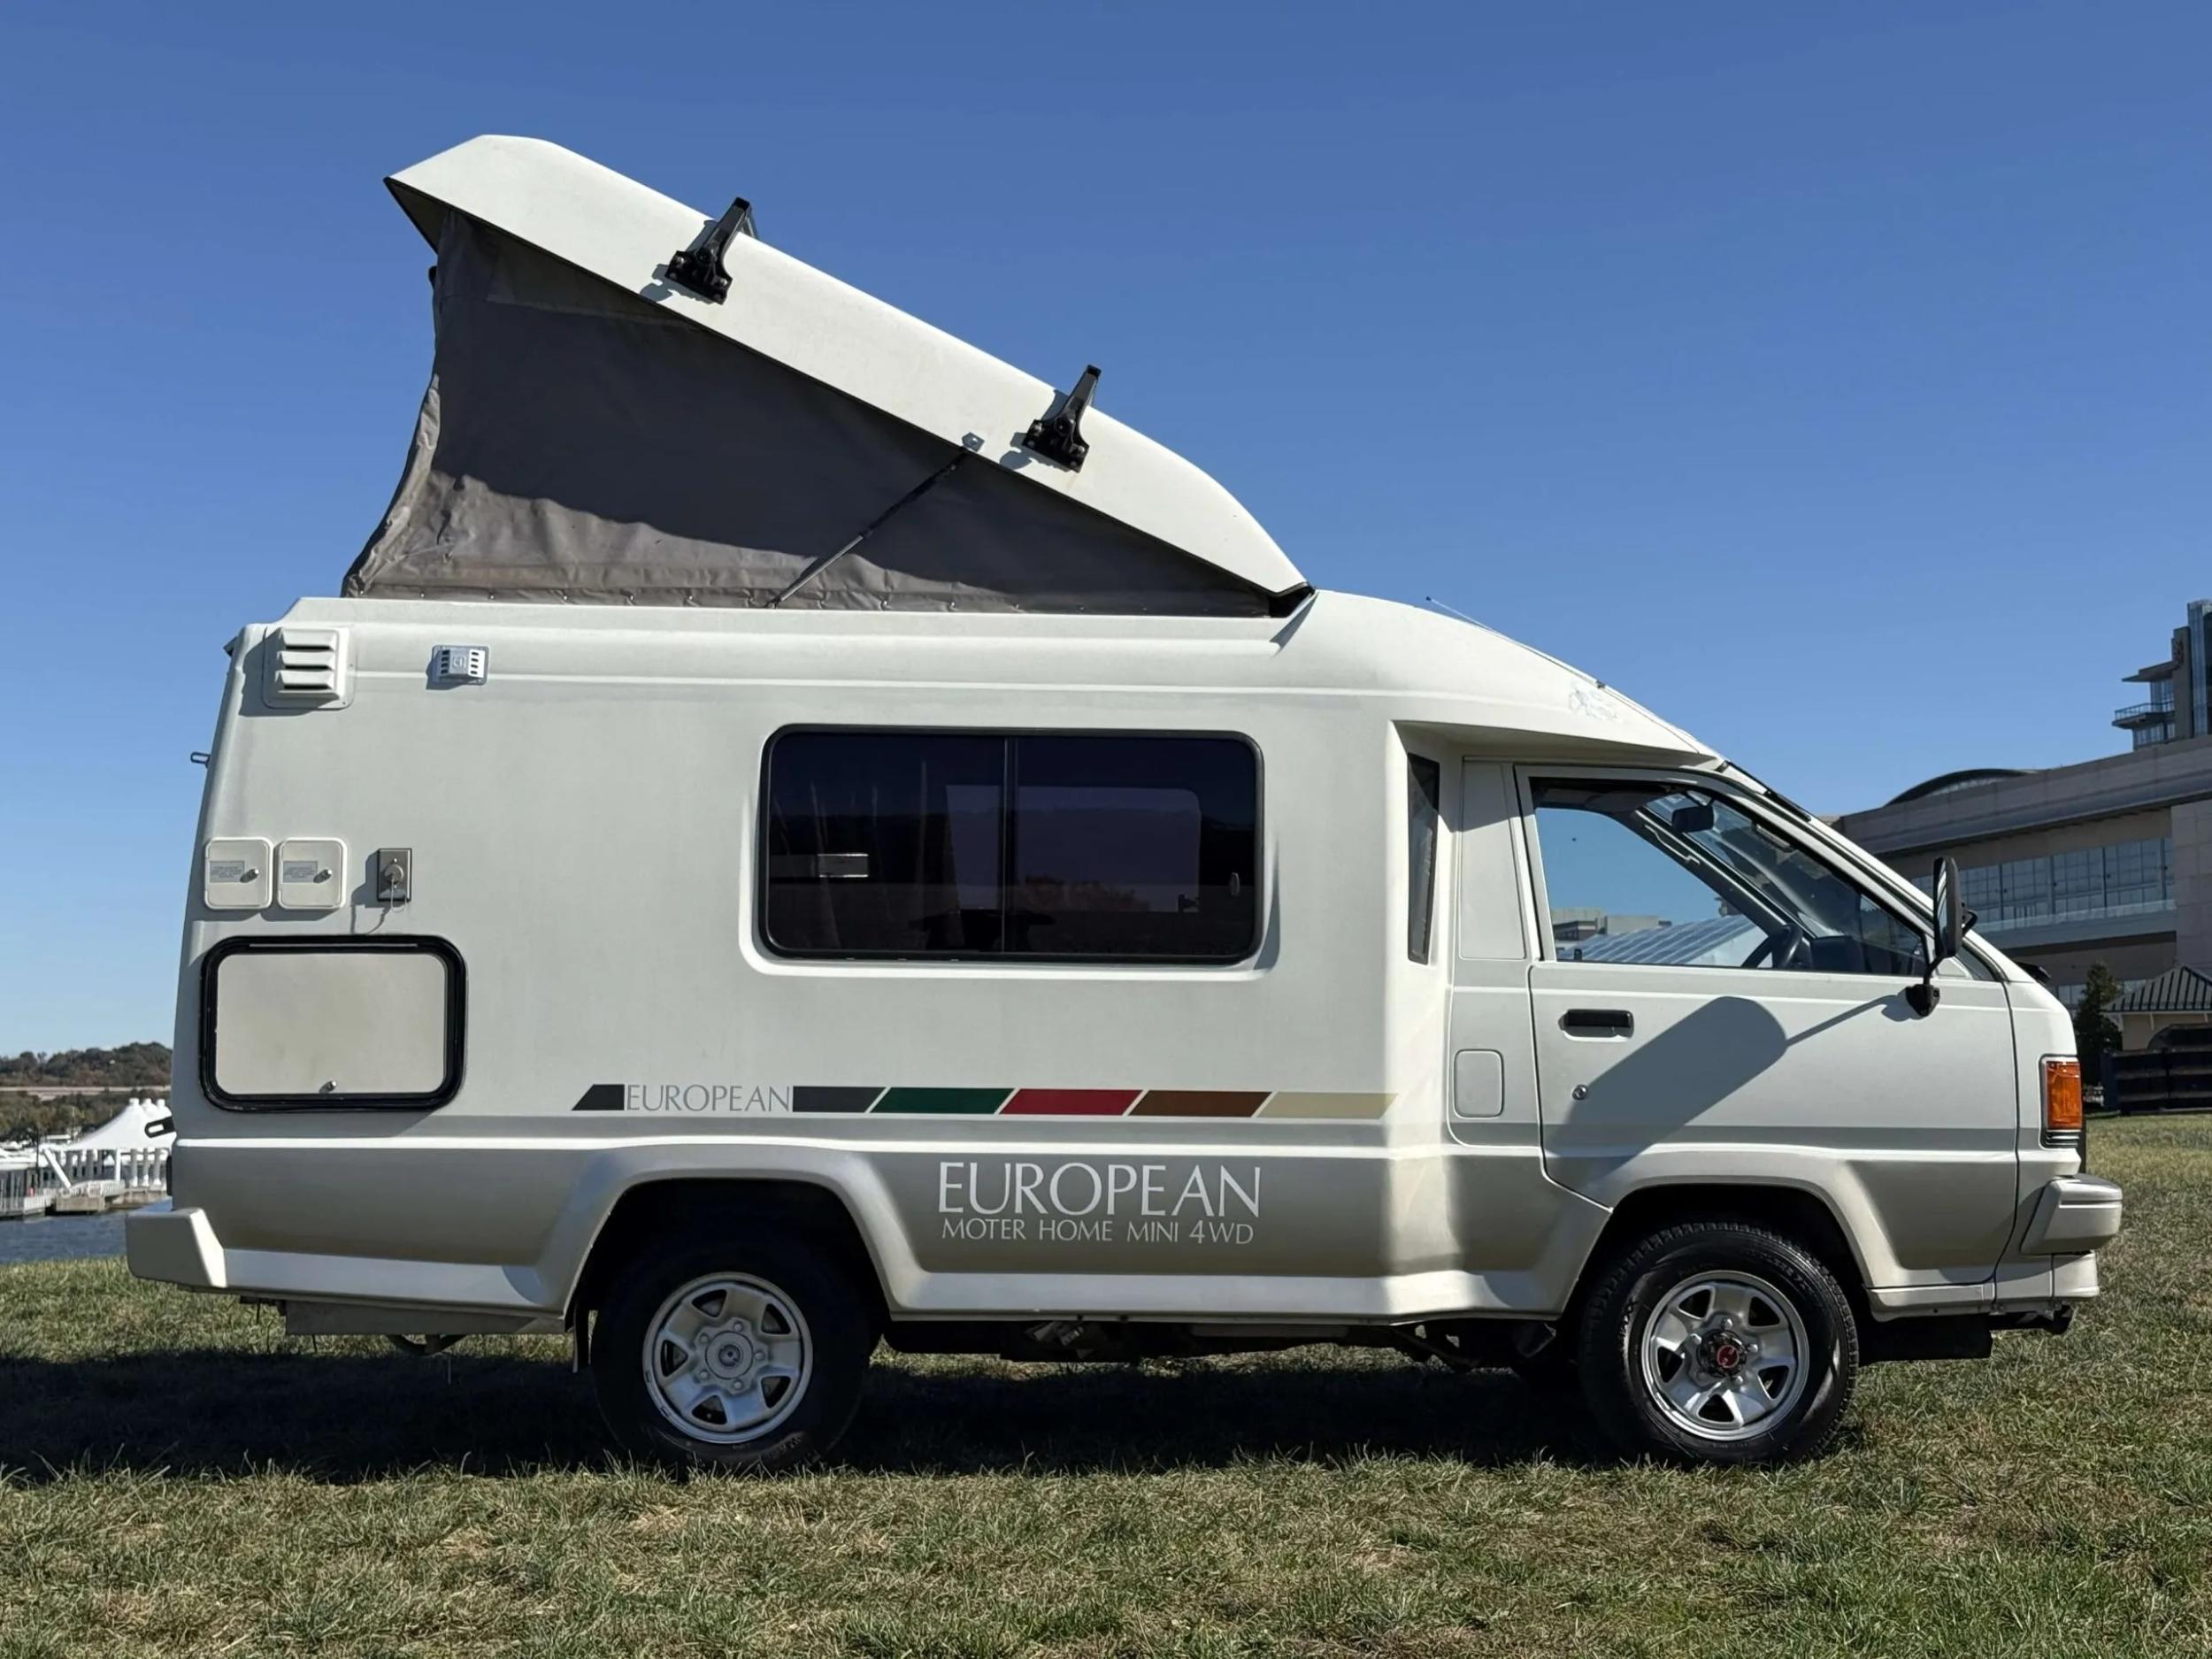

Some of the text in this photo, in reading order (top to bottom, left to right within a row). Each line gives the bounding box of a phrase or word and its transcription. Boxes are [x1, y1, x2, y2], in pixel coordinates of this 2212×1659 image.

[626, 1085, 791, 1112] EUROPEAN
[938, 1162, 1261, 1218] EUROPEAN
[941, 1217, 1254, 1244] MOTER HOME MINI 4WD
